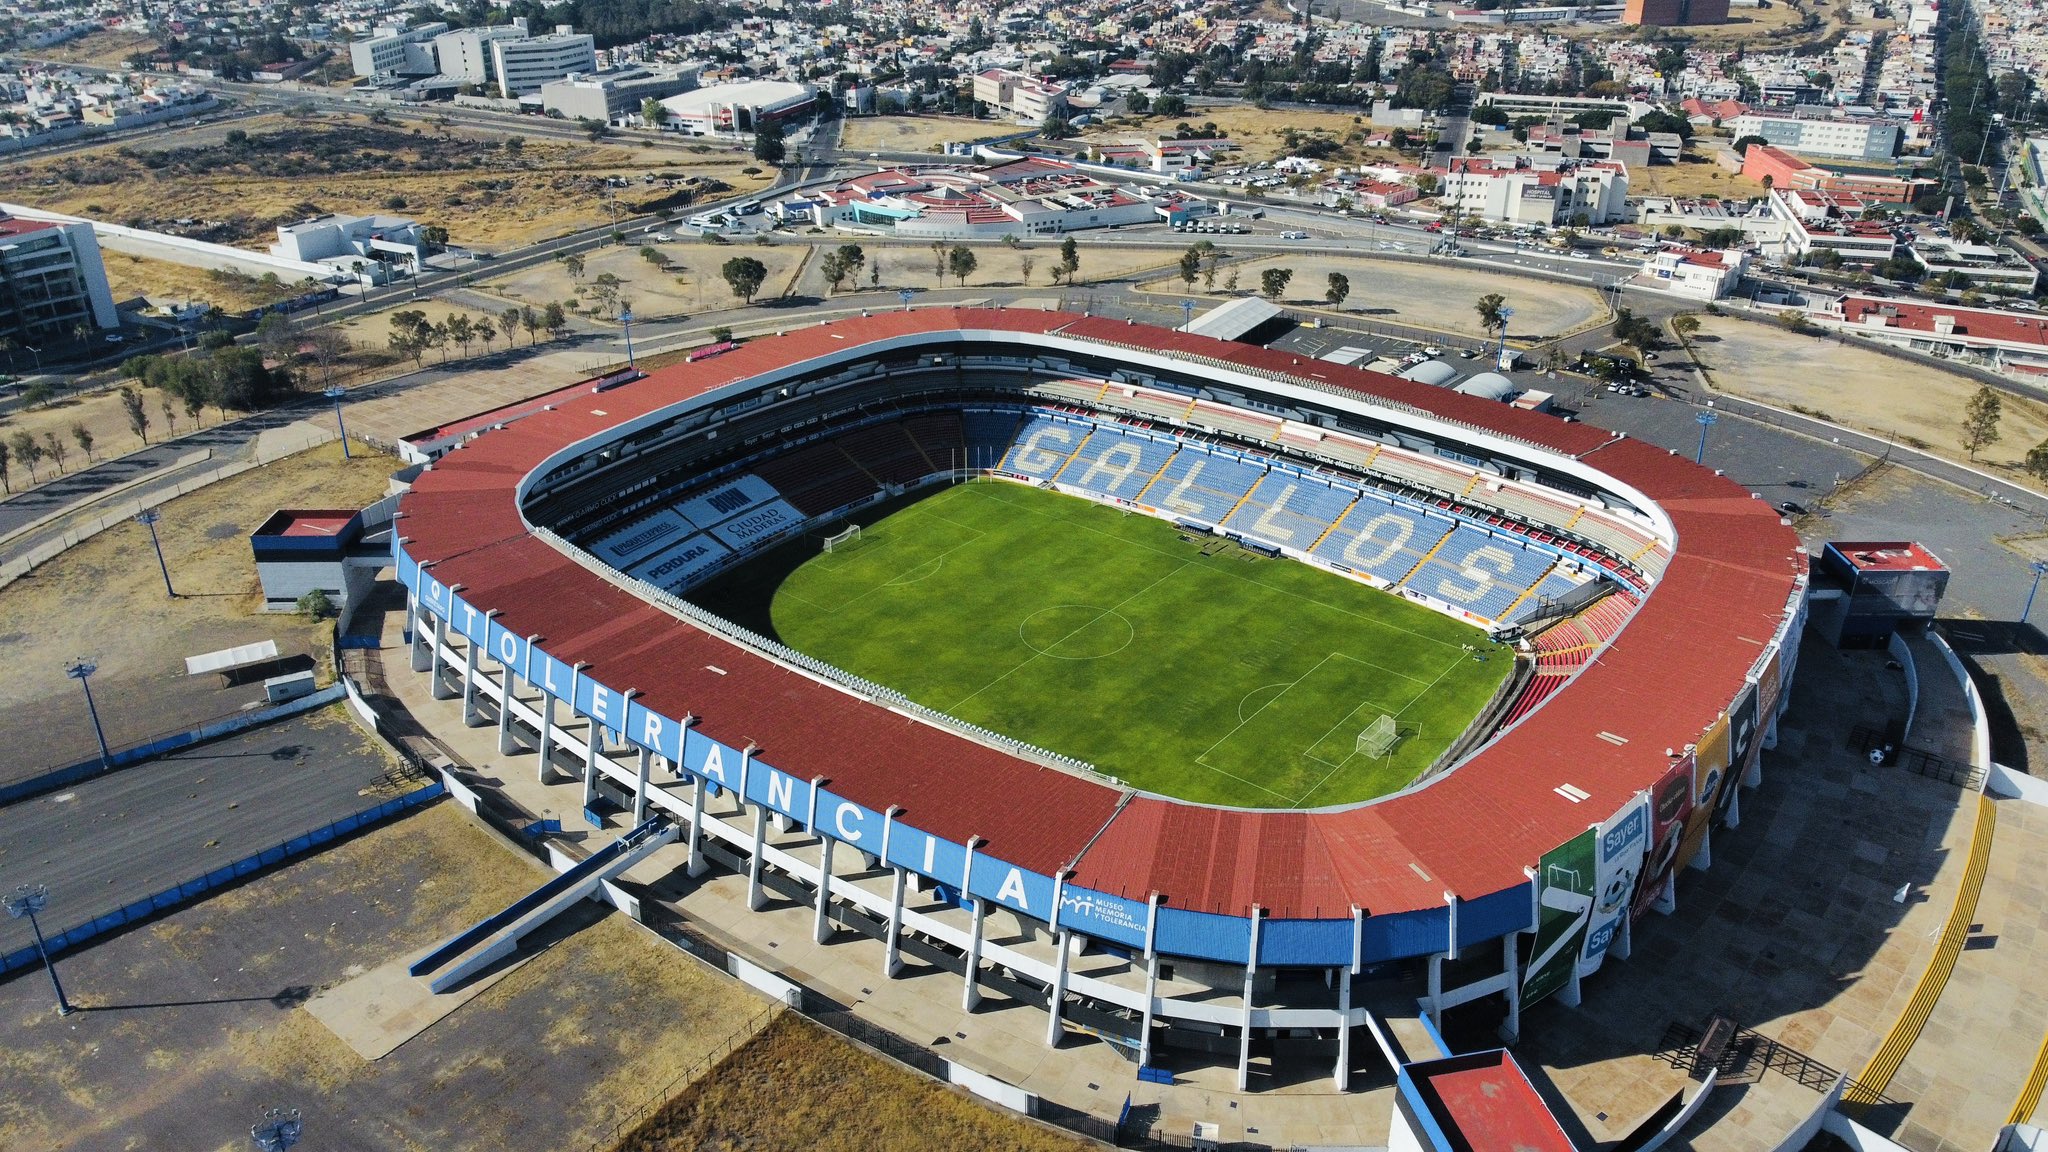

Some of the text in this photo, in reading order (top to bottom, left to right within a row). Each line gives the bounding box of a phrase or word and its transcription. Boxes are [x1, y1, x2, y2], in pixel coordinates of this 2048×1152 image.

[706, 487, 753, 514] BOHN
[1013, 426, 1516, 602] GALLOS
[727, 508, 779, 534] CIUDAD
[736, 513, 787, 540] MADERAS
[619, 520, 671, 556] PAQUETEXPRESS
[647, 544, 710, 580] PERDURA
[463, 603, 1028, 910] TOLERANCIA
[1606, 815, 1639, 853] Sayer
[1094, 905, 1133, 922] MEMORIA
[1095, 898, 1124, 912] MUSEO
[1100, 913, 1147, 933] TOLERANCIA
